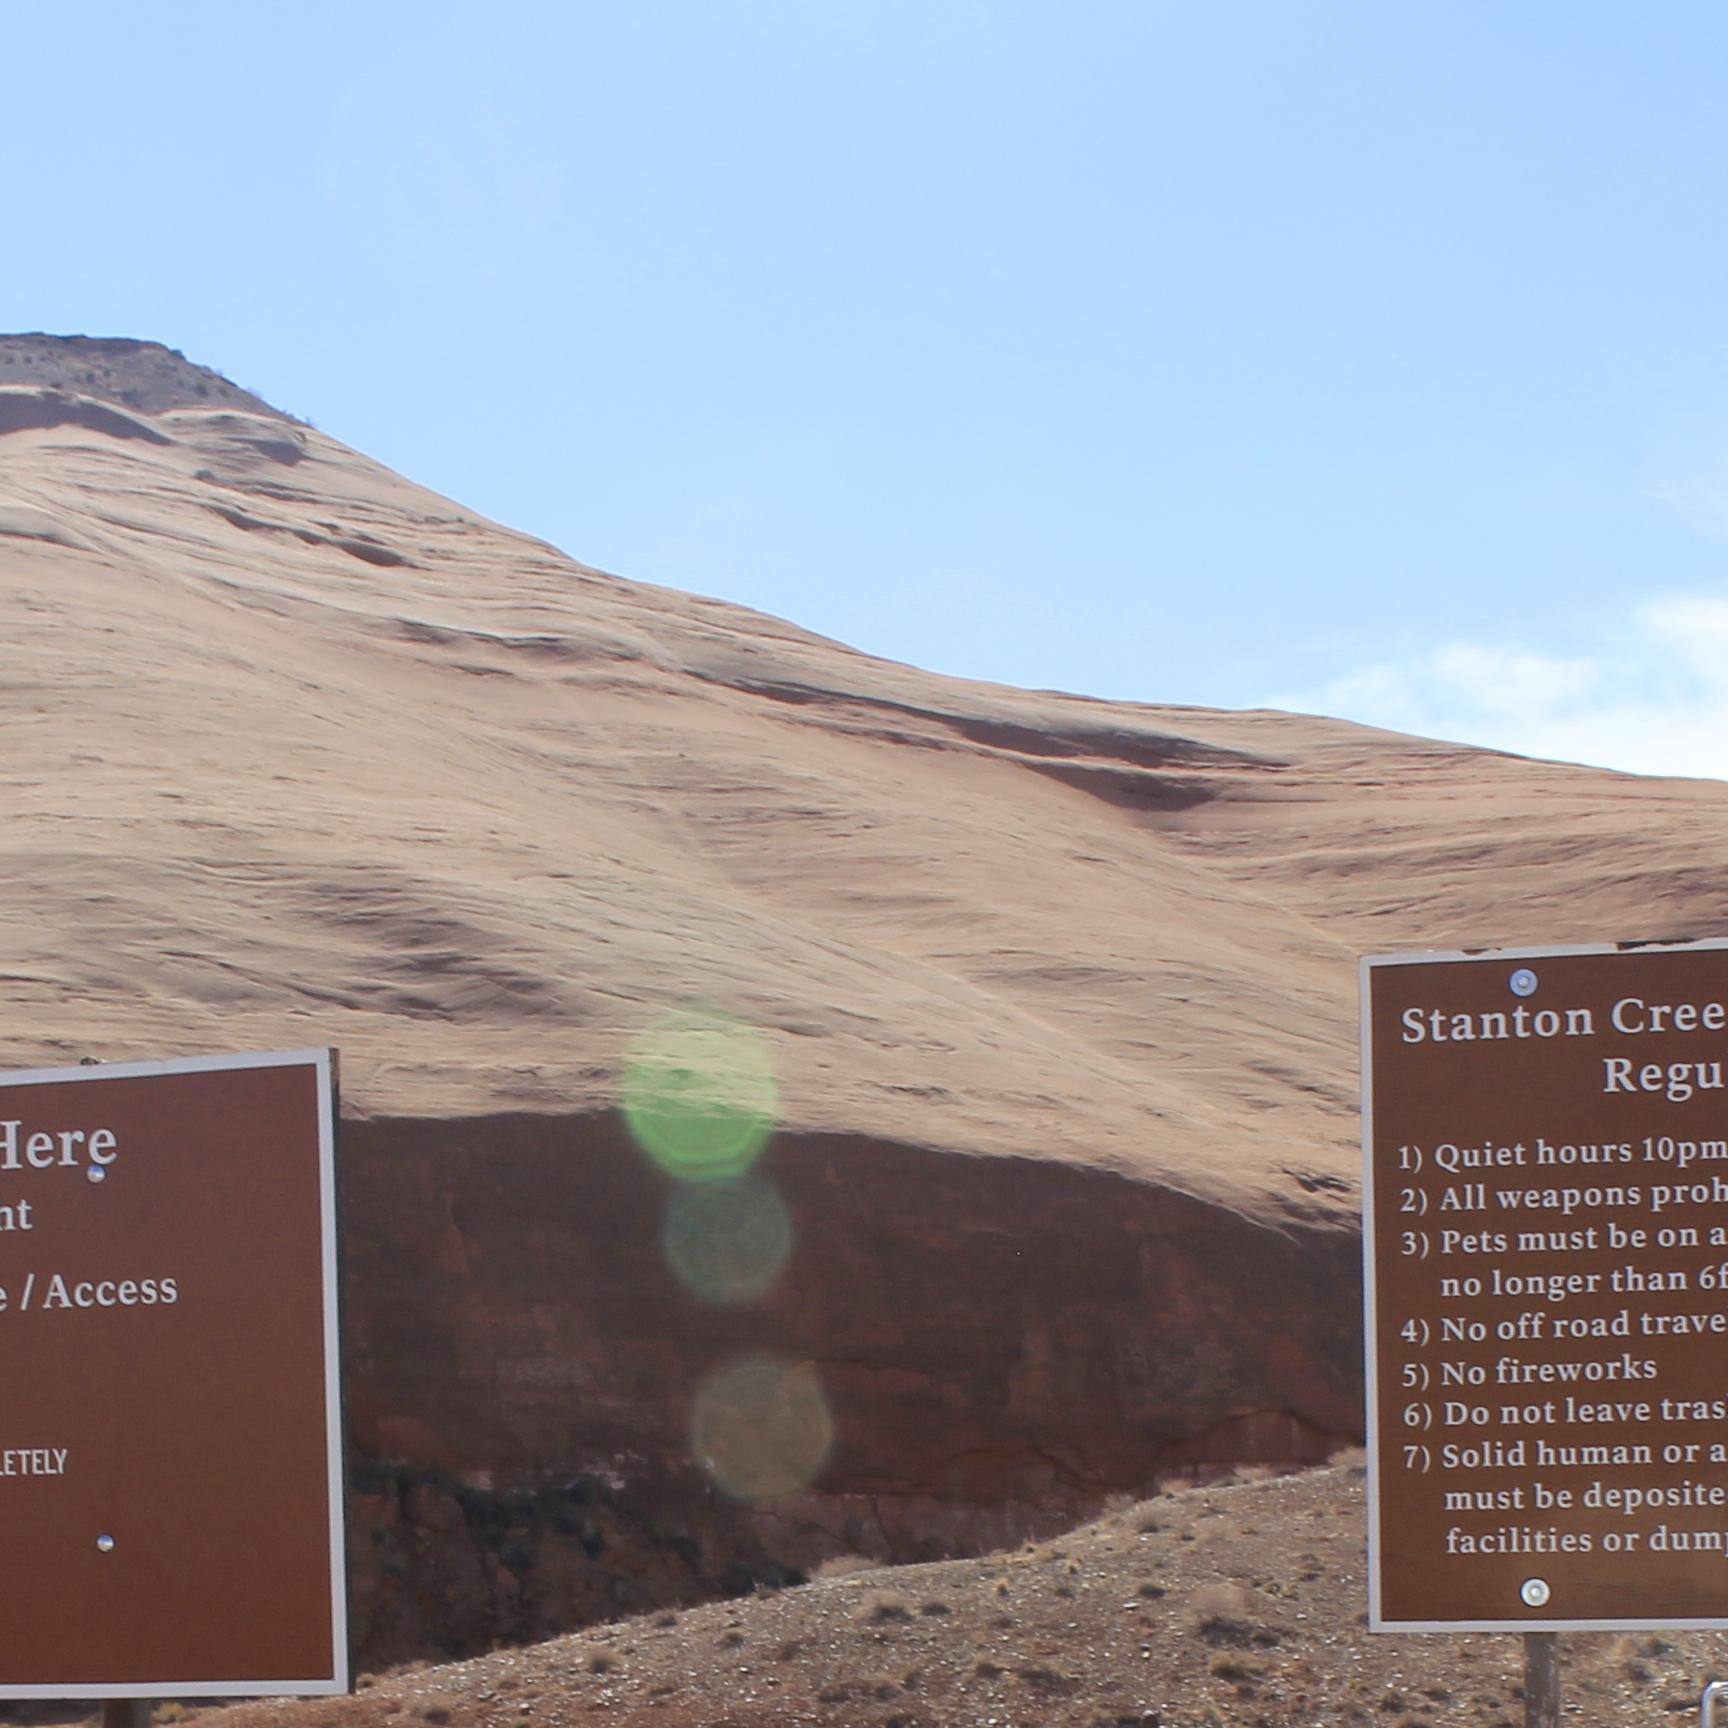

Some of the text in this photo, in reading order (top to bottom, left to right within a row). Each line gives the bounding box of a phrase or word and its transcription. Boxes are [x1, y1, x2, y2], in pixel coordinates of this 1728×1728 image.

[1402, 1005, 1595, 1043] Stanton
[1399, 1145, 1423, 1173] 1)
[1435, 1141, 1527, 1173] Quiet
[1536, 1138, 1633, 1164] hours
[1400, 1188, 1428, 1215] 2)
[1440, 1183, 1486, 1211] All
[1496, 1186, 1641, 1215] weapons
[1402, 1231, 1430, 1259] 3)
[1442, 1230, 1508, 1254] Pets
[1518, 1227, 1598, 1251] must
[1608, 1222, 1647, 1249] be
[1657, 1228, 1699, 1247] on
[1710, 1227, 1728, 1246] a
[20, 1273, 35, 1311] /
[42, 1274, 178, 1309] Access
[1441, 1277, 1482, 1297] no
[1492, 1269, 1602, 1302] longer
[1611, 1265, 1688, 1292] than
[1400, 1319, 1430, 1346] 4)
[1441, 1317, 1487, 1341] No
[1497, 1311, 1546, 1340] off
[1553, 1309, 1630, 1338] road
[1402, 1353, 1657, 1391] 5) No fireworks
[1404, 1402, 1432, 1429] 6)
[1445, 1401, 1490, 1426] Do
[1500, 1401, 1556, 1424] not
[1566, 1396, 1651, 1423] leave
[1403, 1445, 1431, 1473] 7)
[1443, 1440, 1526, 1468] Solid
[1537, 1439, 1652, 1466] human
[1663, 1444, 1701, 1464] or
[1445, 1487, 1525, 1510] must
[1534, 1482, 1573, 1509] be
[1446, 1526, 1593, 1554] facilities
[1602, 1533, 1640, 1552] or
